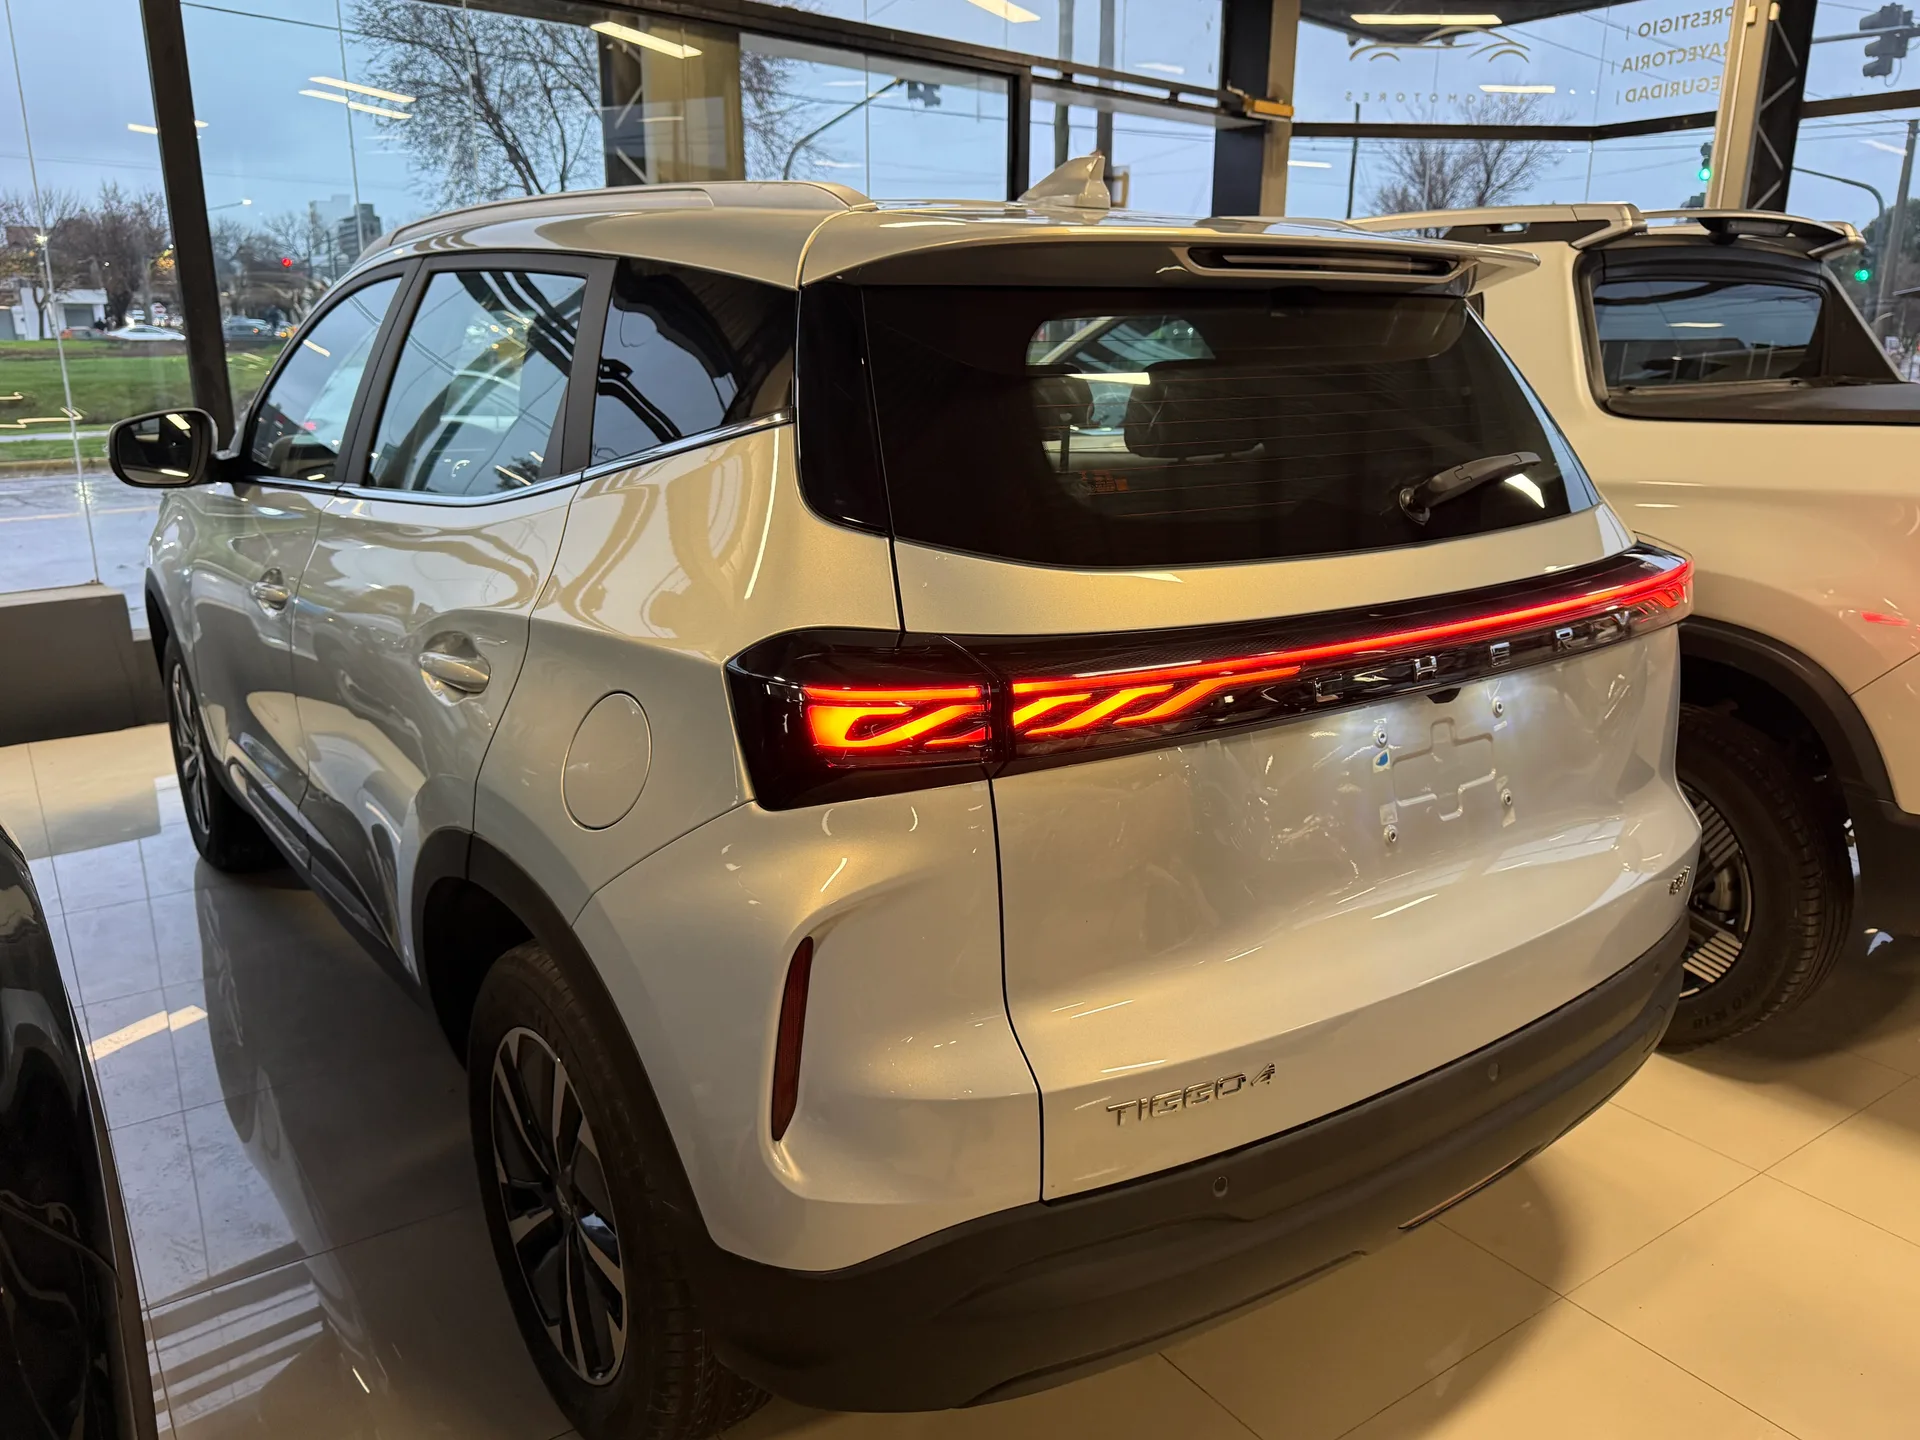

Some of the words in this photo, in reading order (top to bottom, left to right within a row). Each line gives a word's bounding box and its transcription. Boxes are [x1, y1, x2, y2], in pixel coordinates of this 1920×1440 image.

[1314, 609, 1632, 703] CHERY
[1105, 1072, 1247, 1126] TIGGO
[1250, 1062, 1276, 1087] 4
